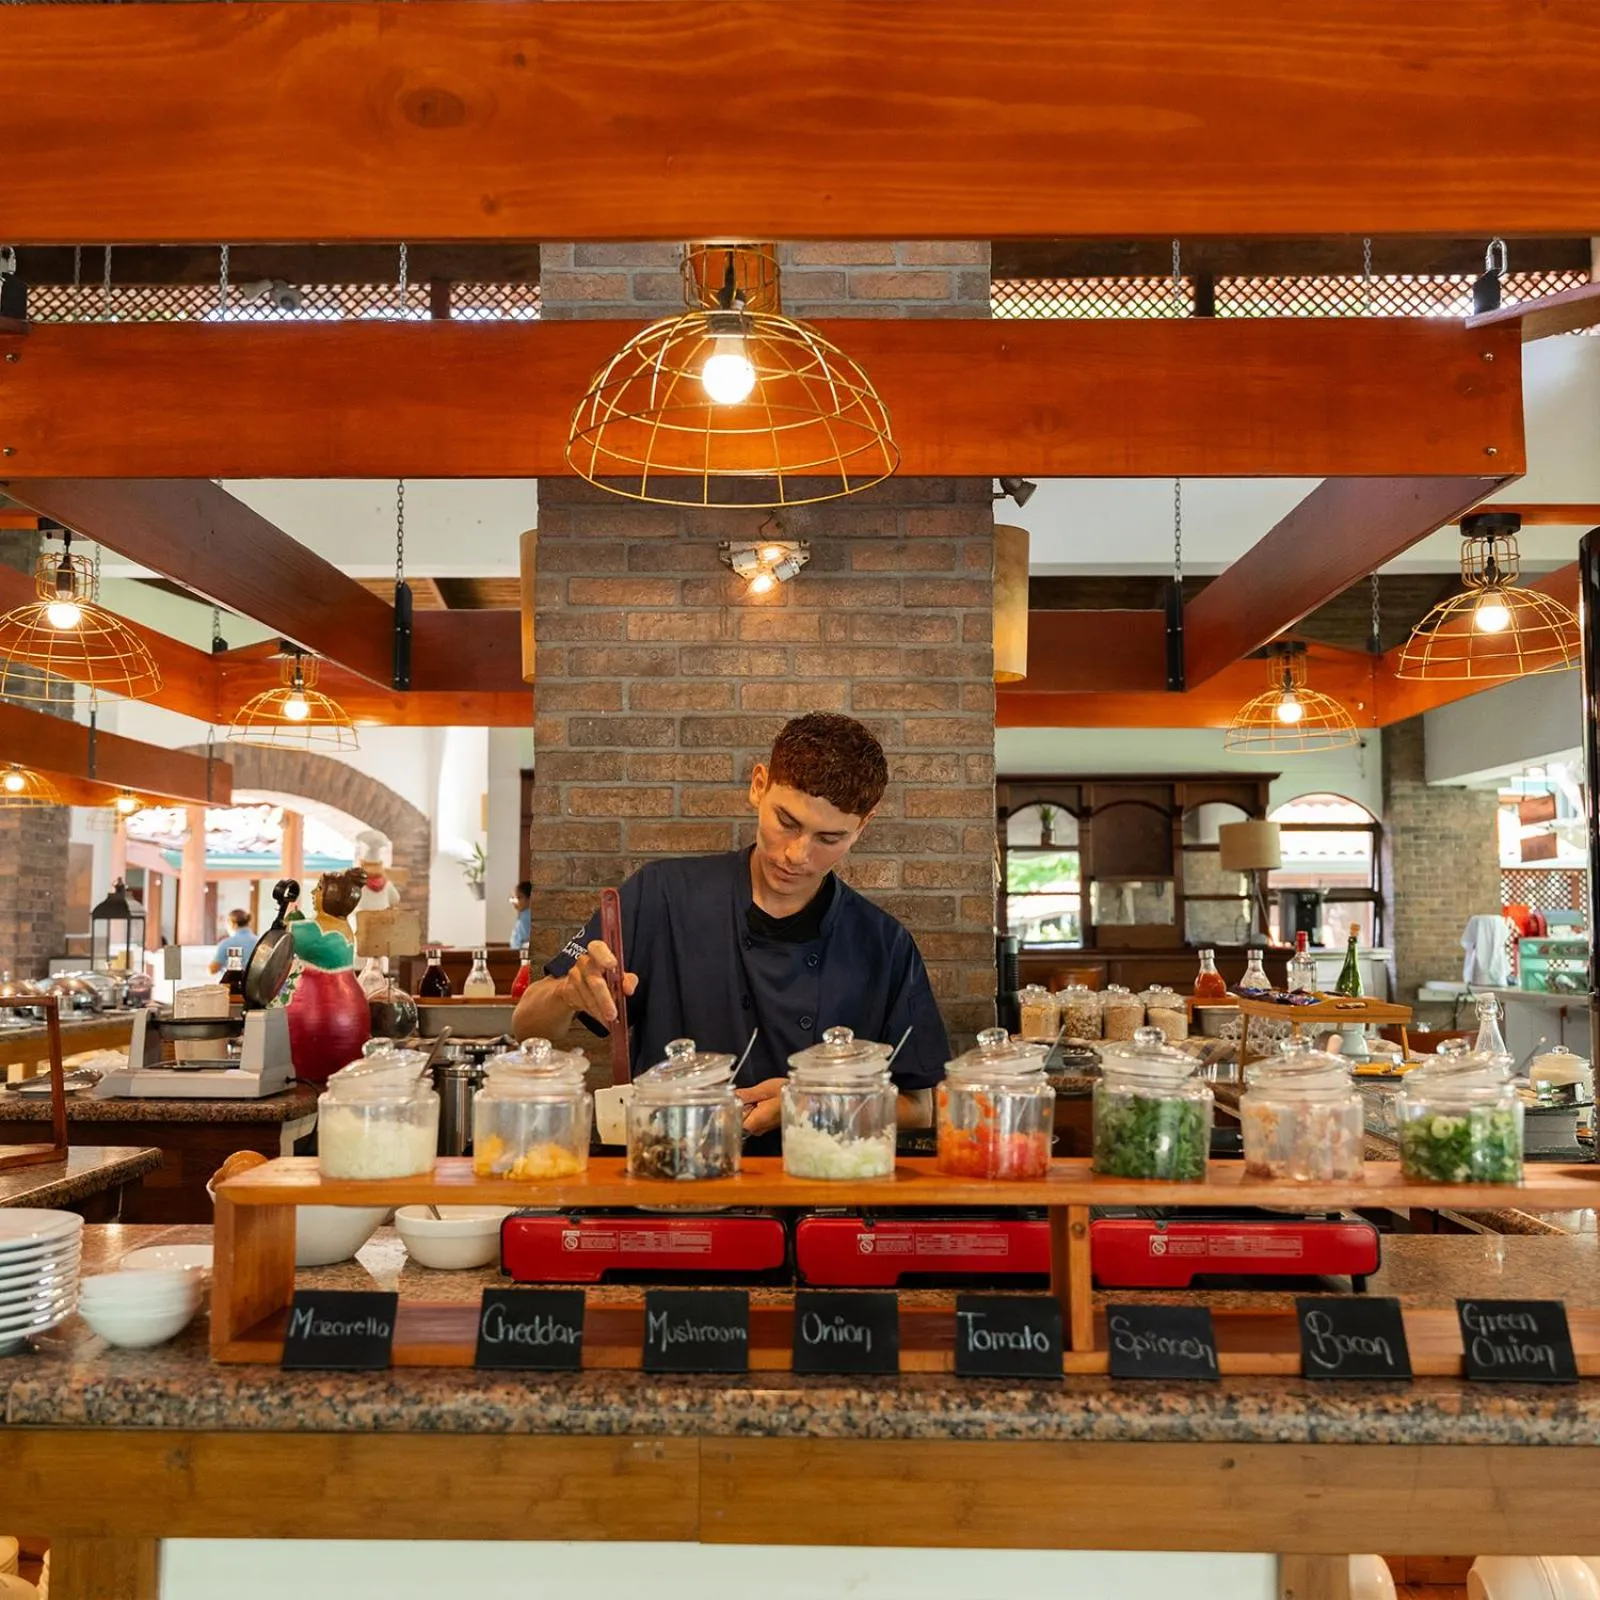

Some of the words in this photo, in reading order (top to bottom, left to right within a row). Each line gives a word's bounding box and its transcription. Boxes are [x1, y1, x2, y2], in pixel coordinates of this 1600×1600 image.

[482, 1303, 582, 1345] Cheddar
[648, 1311, 747, 1352] Mushroom
[802, 1312, 872, 1352] Onion
[957, 1311, 1050, 1352] Tomato
[1305, 1310, 1395, 1368] Bacon
[1463, 1303, 1538, 1336] Green
[1472, 1336, 1556, 1373] Onion
